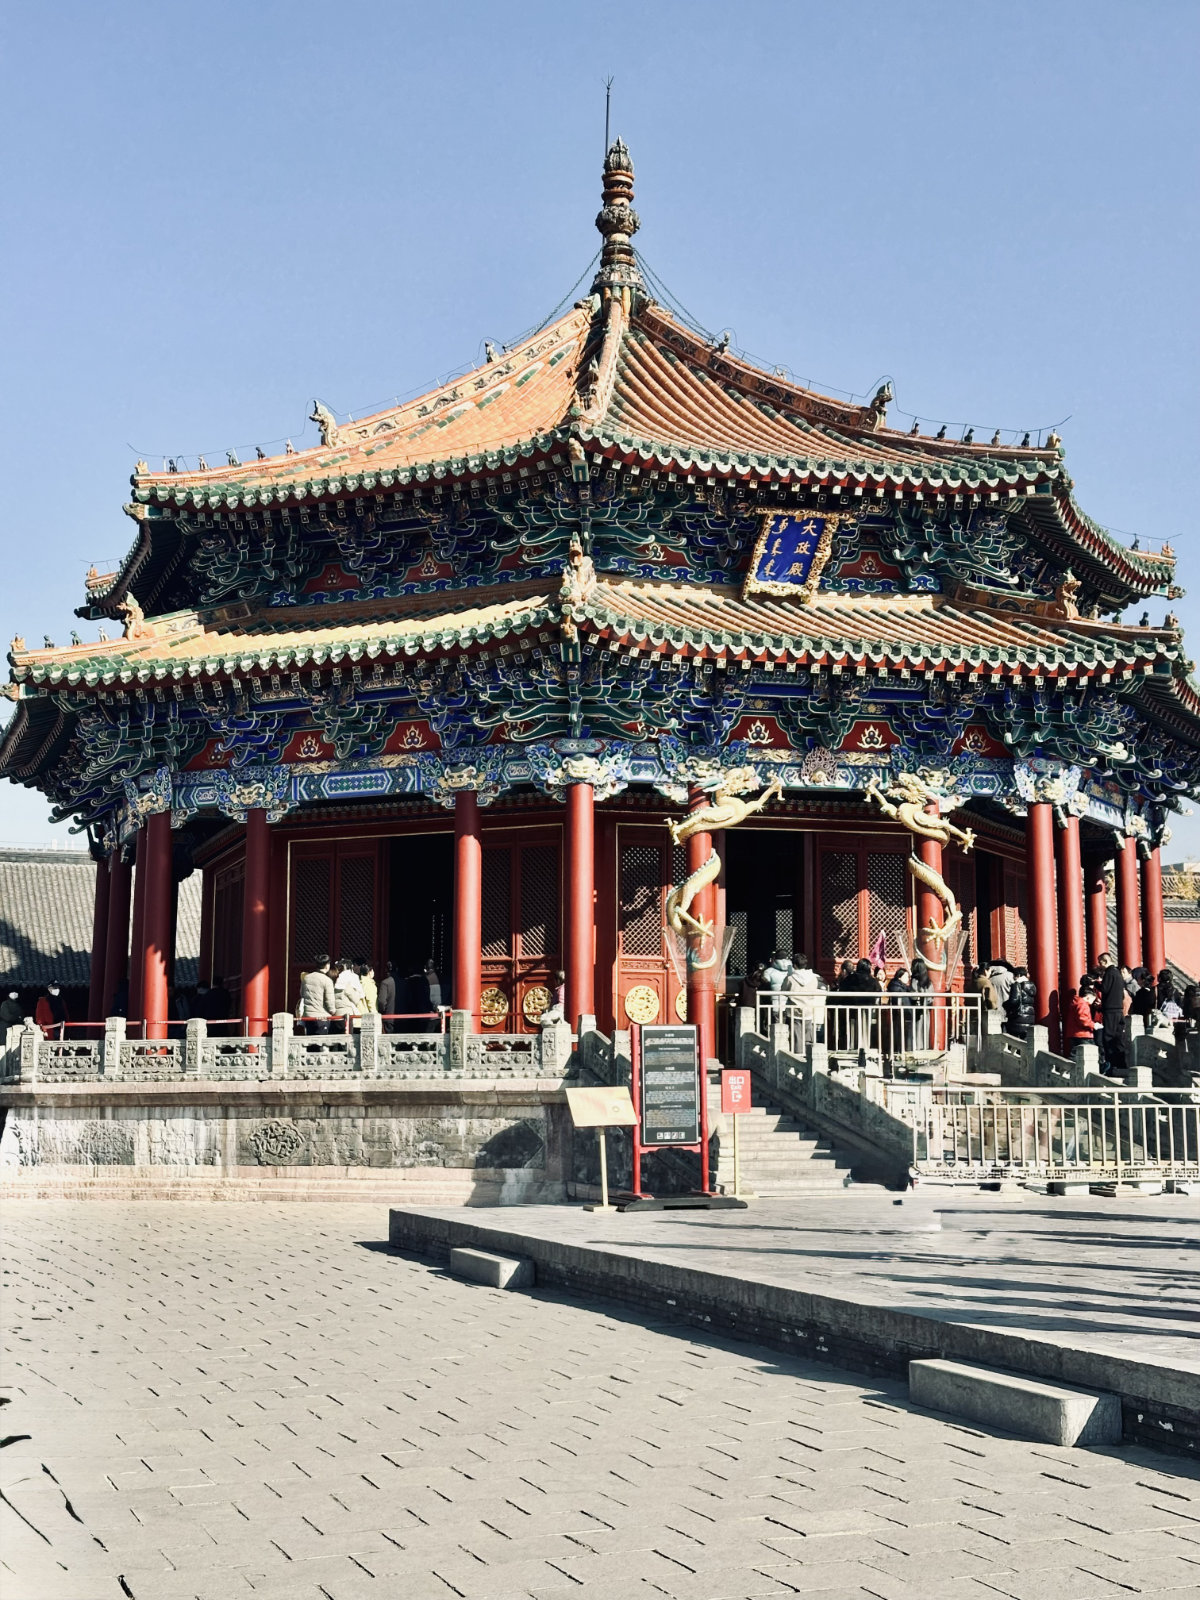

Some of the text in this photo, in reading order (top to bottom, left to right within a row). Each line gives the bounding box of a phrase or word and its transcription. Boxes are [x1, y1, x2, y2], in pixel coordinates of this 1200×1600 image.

[786, 520, 818, 577] 大政殿
[728, 1075, 745, 1085] 出口
